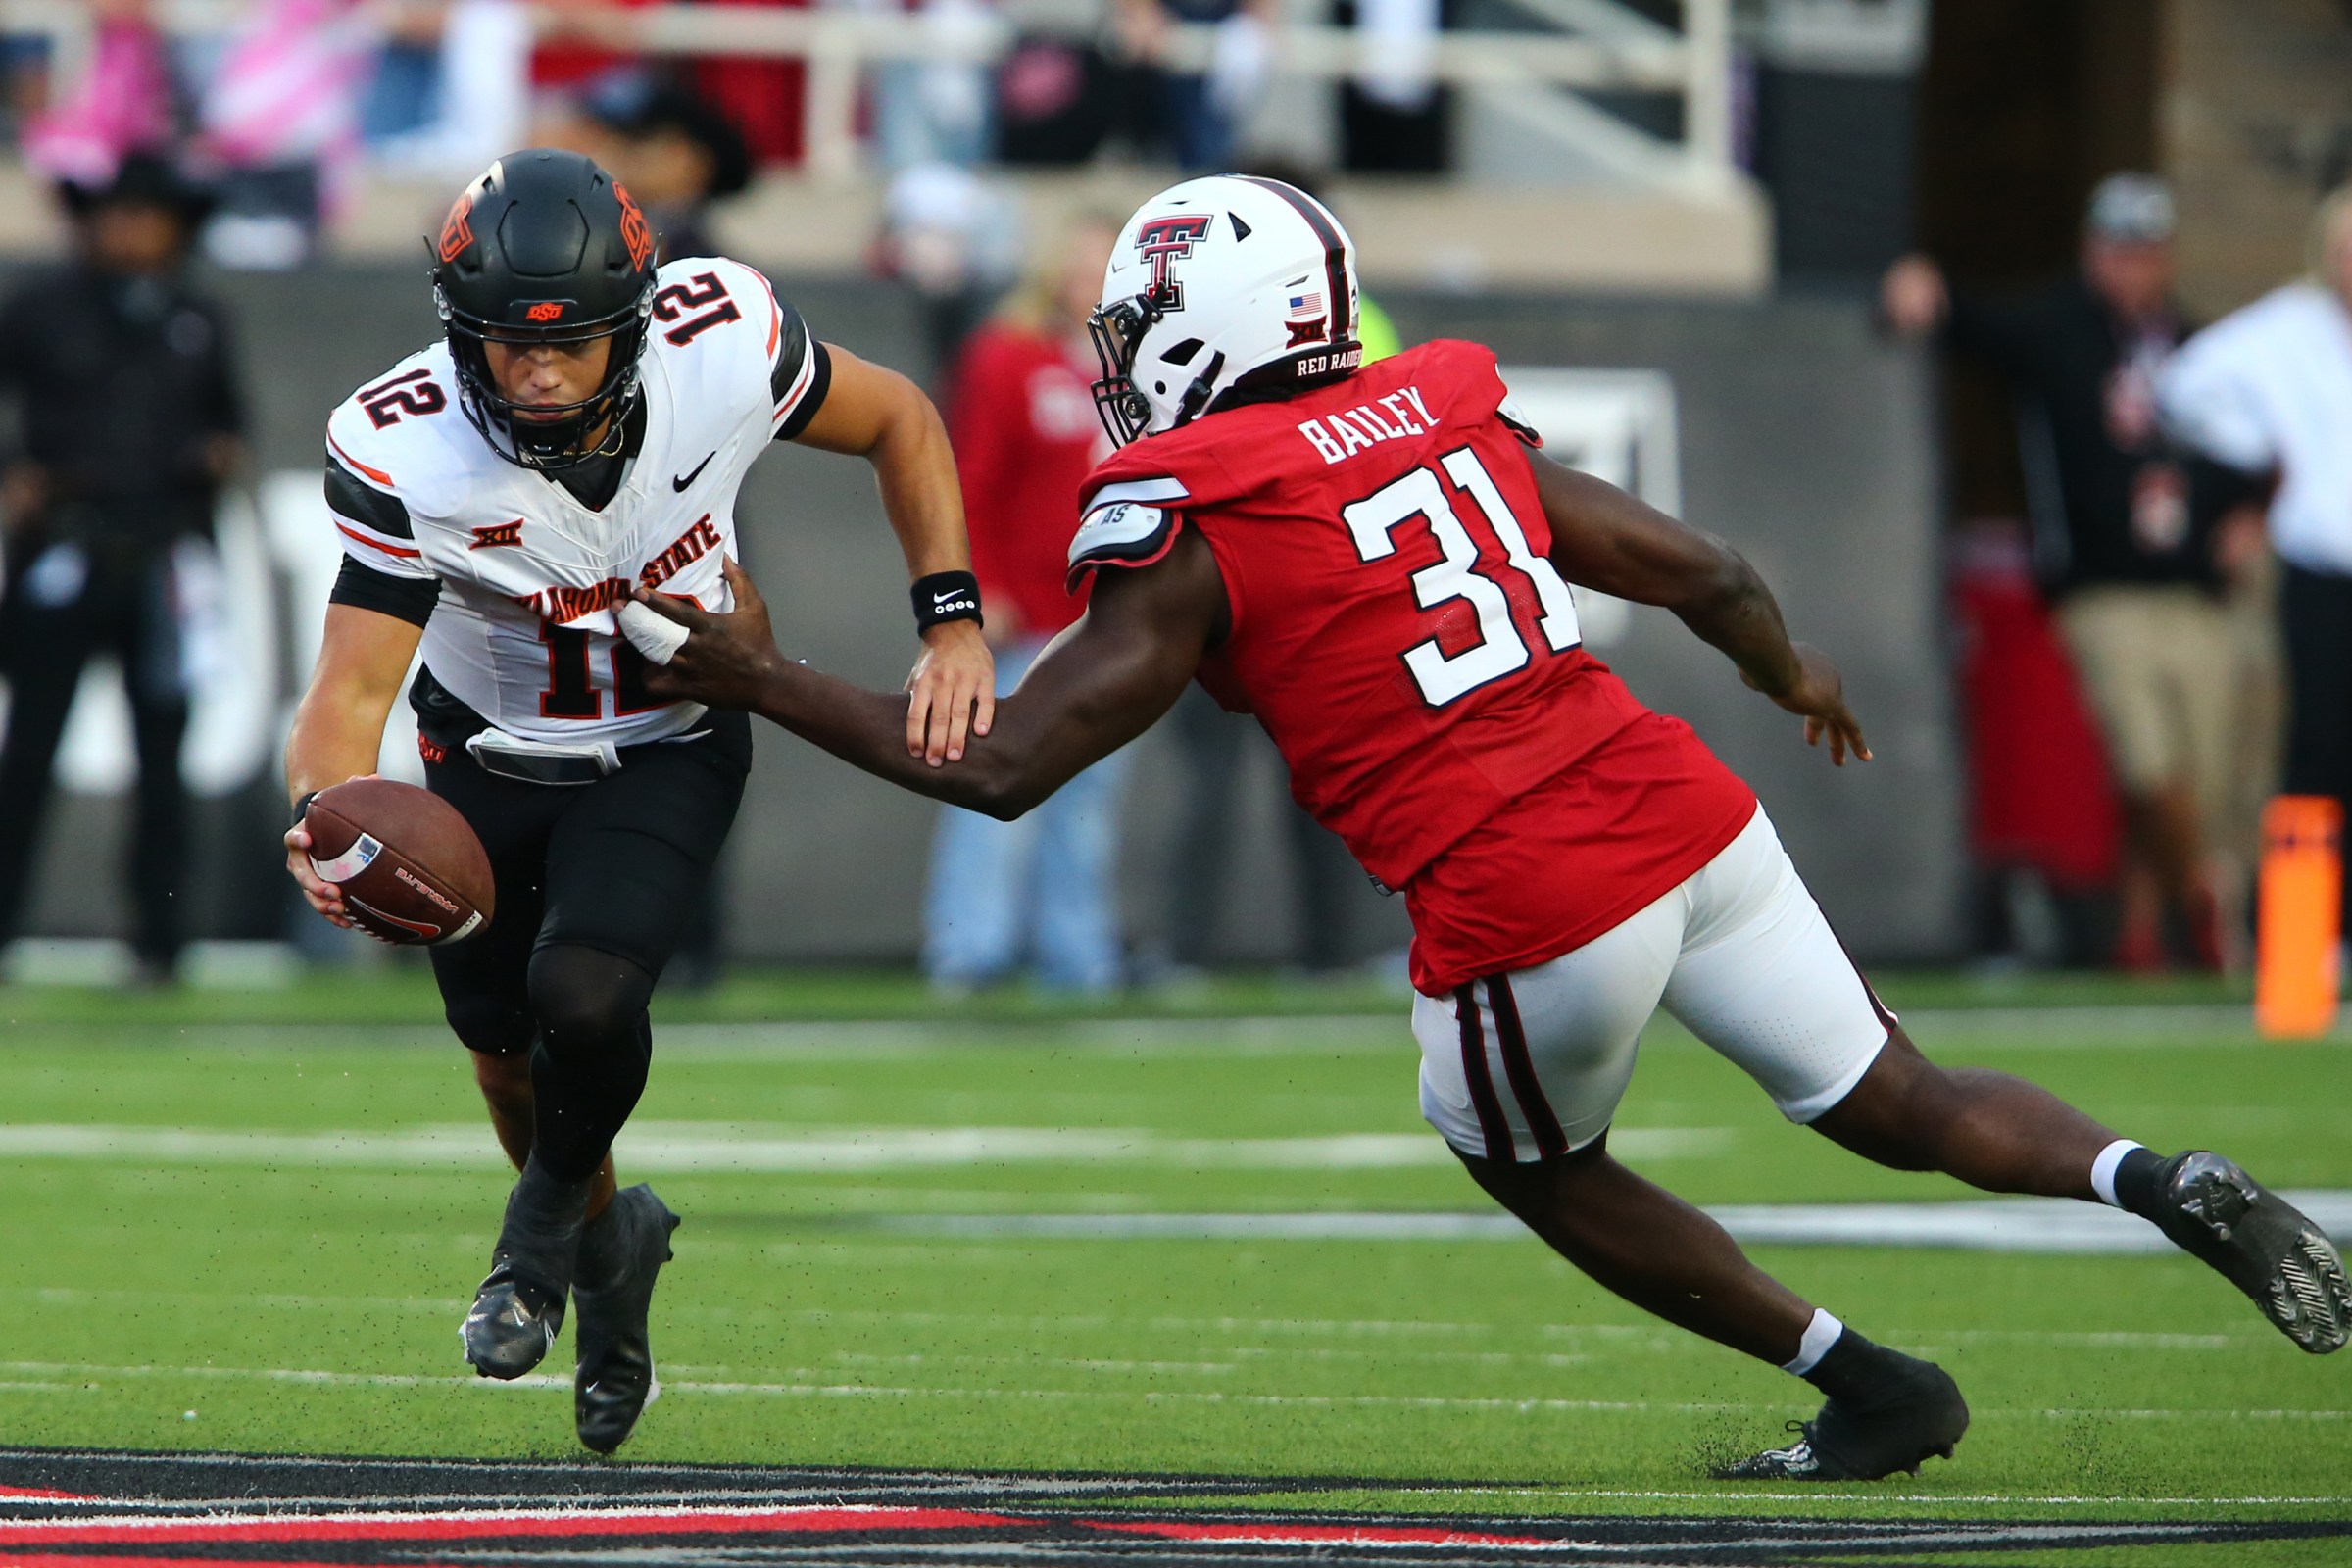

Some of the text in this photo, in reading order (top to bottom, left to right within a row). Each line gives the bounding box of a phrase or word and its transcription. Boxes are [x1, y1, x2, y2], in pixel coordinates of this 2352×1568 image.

[526, 301, 564, 322] OSU
[652, 270, 742, 348] 12
[356, 368, 448, 431] 12
[1298, 355, 1327, 377] RED
[1297, 385, 1441, 465] BAILEY
[639, 512, 722, 589] STATE
[1338, 442, 1583, 711] 31
